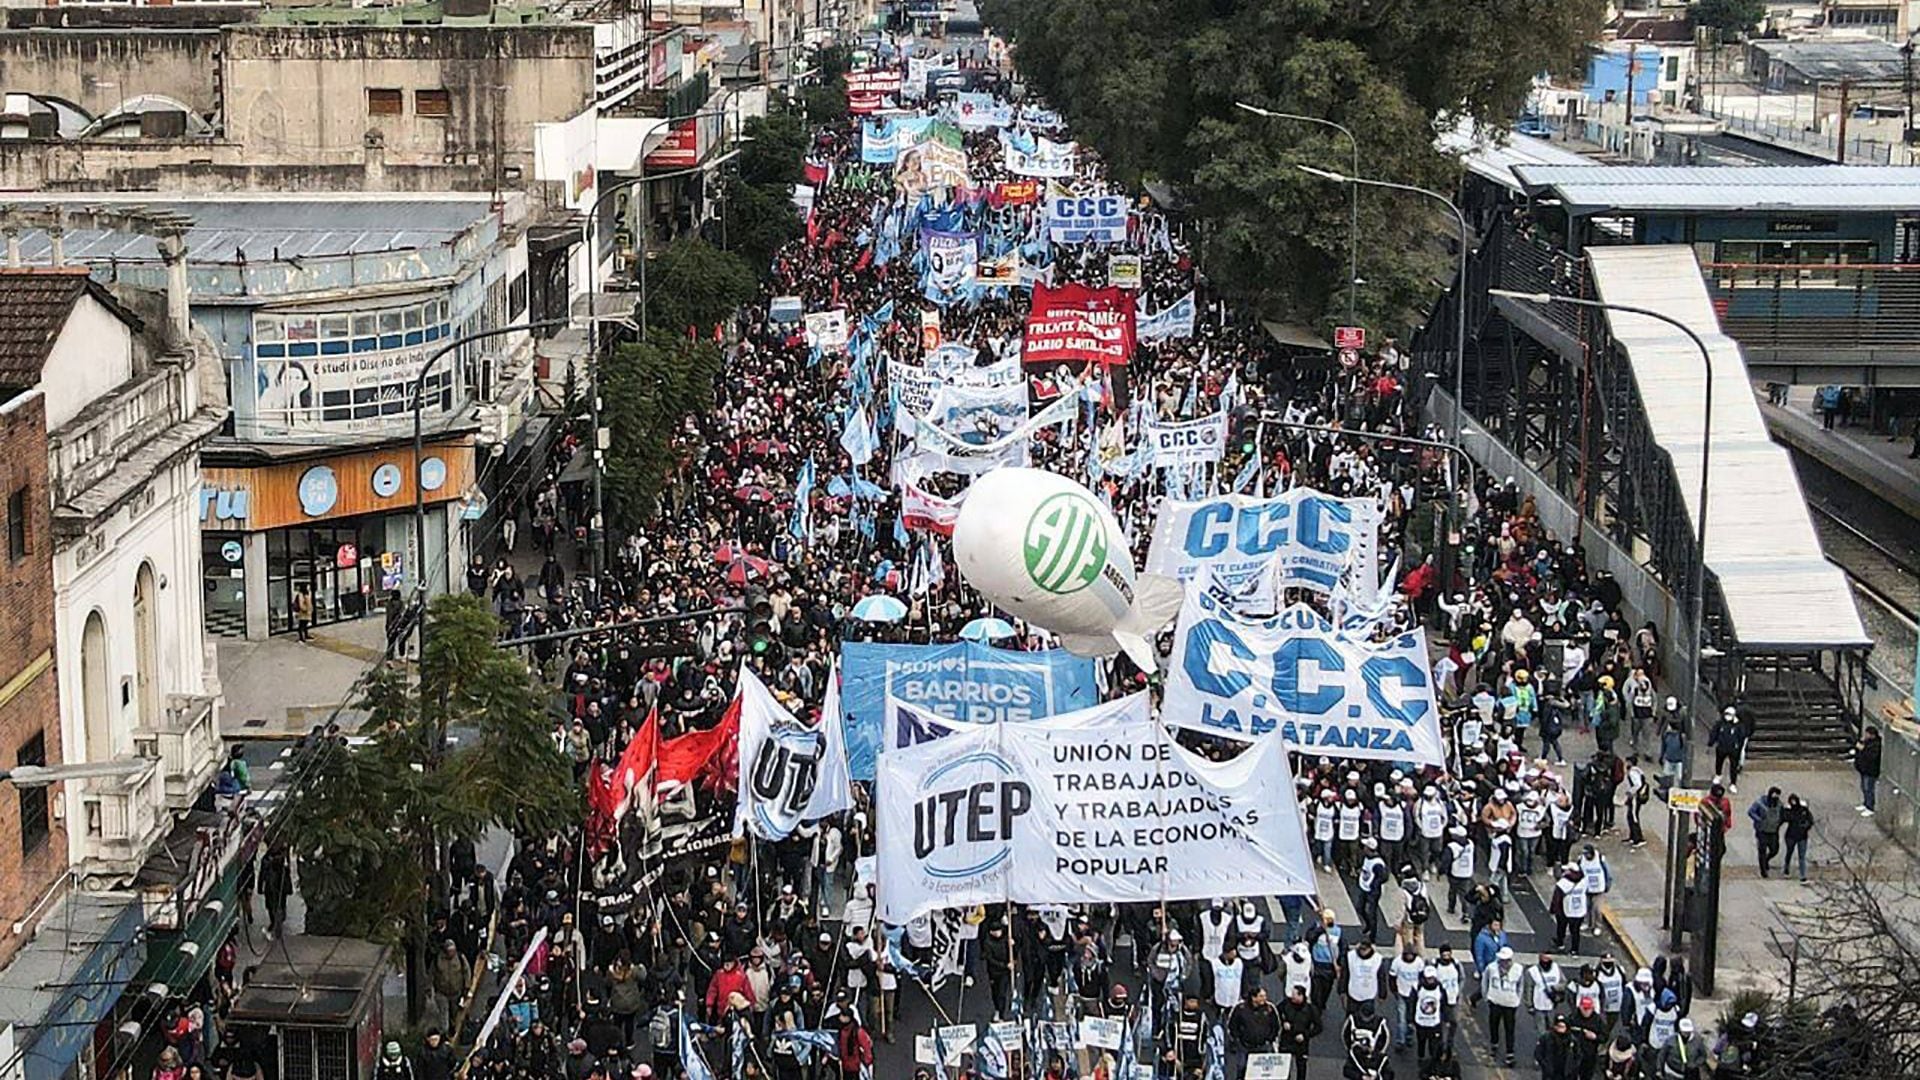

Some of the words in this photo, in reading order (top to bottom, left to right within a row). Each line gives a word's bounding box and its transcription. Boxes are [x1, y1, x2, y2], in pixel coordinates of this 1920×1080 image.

[1057, 198, 1118, 217] CCC
[1029, 320, 1075, 335] FRENTE
[1184, 496, 1352, 559] CCC
[1028, 498, 1106, 593] ATE
[906, 681, 1032, 705] BARRIOS
[968, 704, 1032, 724] PIE
[1201, 702, 1243, 734] LA
[1250, 715, 1415, 752] MATANZA
[1054, 738, 1132, 763] UNIÓN
[1142, 743, 1171, 761] DE
[914, 781, 1032, 860] UTEP
[1055, 803, 1068, 820] Y
[1078, 797, 1259, 825] TRABAJADOAS
[1056, 831, 1086, 848] DE
[1095, 831, 1125, 847] LA
[1134, 822, 1253, 846] ECONOM
[1056, 856, 1169, 876] POPULAR
